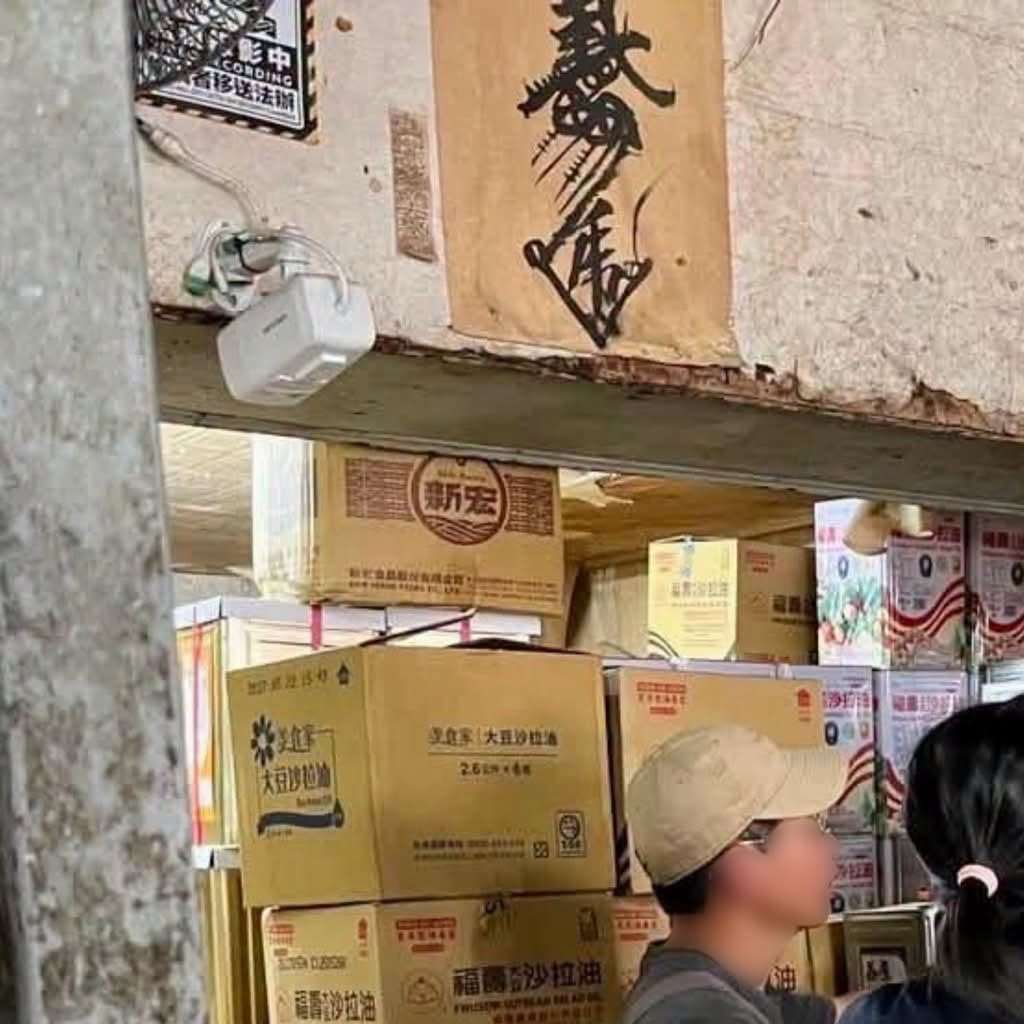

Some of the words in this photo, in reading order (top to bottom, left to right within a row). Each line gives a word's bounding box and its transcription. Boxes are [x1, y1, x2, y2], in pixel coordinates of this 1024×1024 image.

[423, 480, 498, 516] 新宏
[484, 728, 559, 748] 大豆沙拉油
